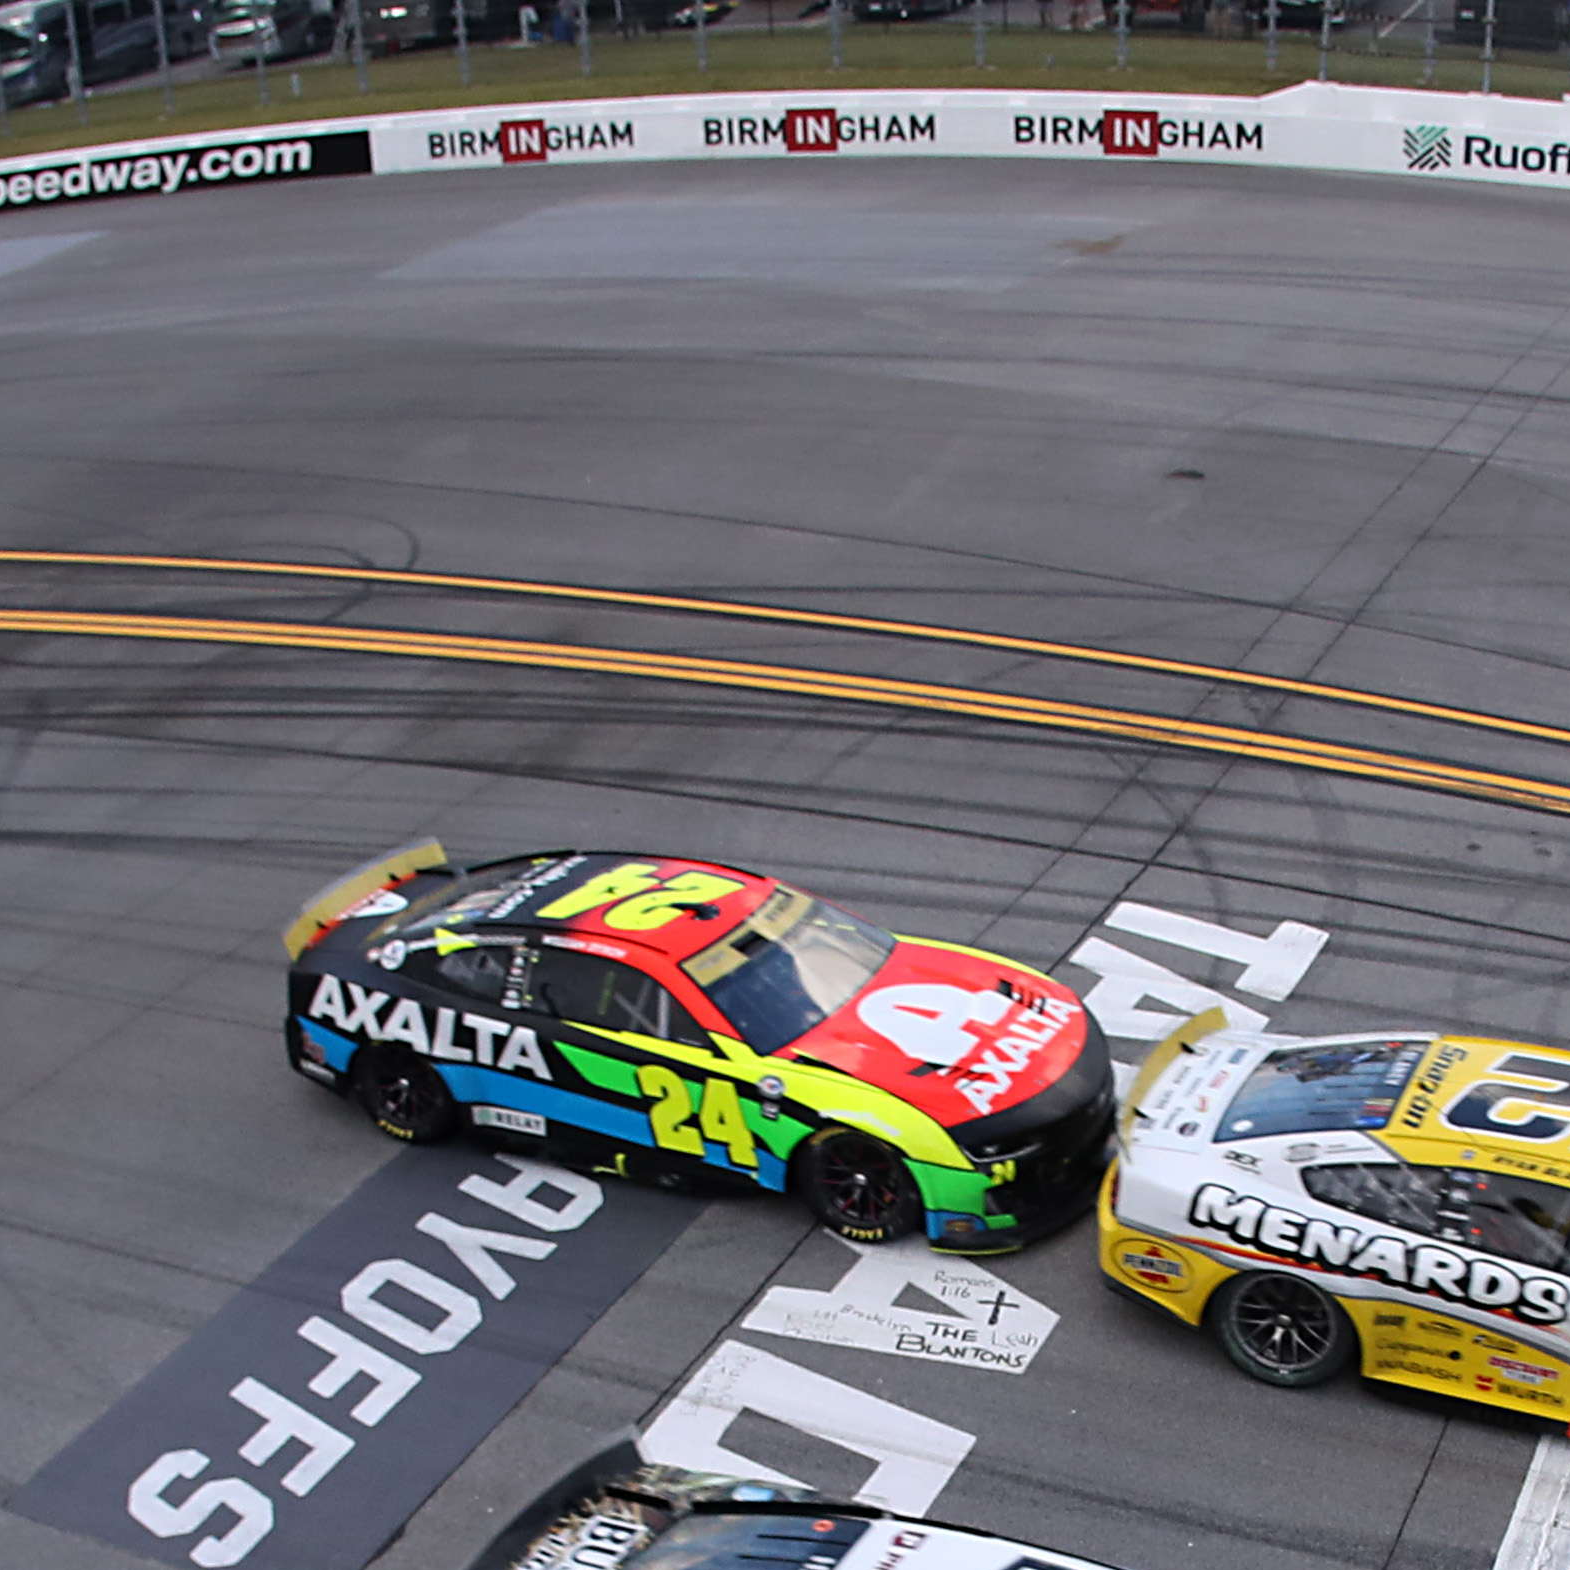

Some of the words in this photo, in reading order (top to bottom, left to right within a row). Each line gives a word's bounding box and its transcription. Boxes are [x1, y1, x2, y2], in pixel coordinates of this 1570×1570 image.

[429, 120, 633, 161] BIRMINGHAM
[704, 111, 936, 151] BIRMINGHAM
[1015, 112, 1263, 153] BIRMINGHAM
[535, 863, 747, 931] 24
[308, 973, 554, 1081] AXALTA
[954, 996, 1084, 1117] AXALTA
[636, 1063, 760, 1170] 24
[1190, 1183, 1570, 1327] MENARDS
[126, 1153, 605, 1570] AYOFFS
[894, 1333, 1029, 1370] BLANTONS
[925, 1320, 979, 1344] THE
